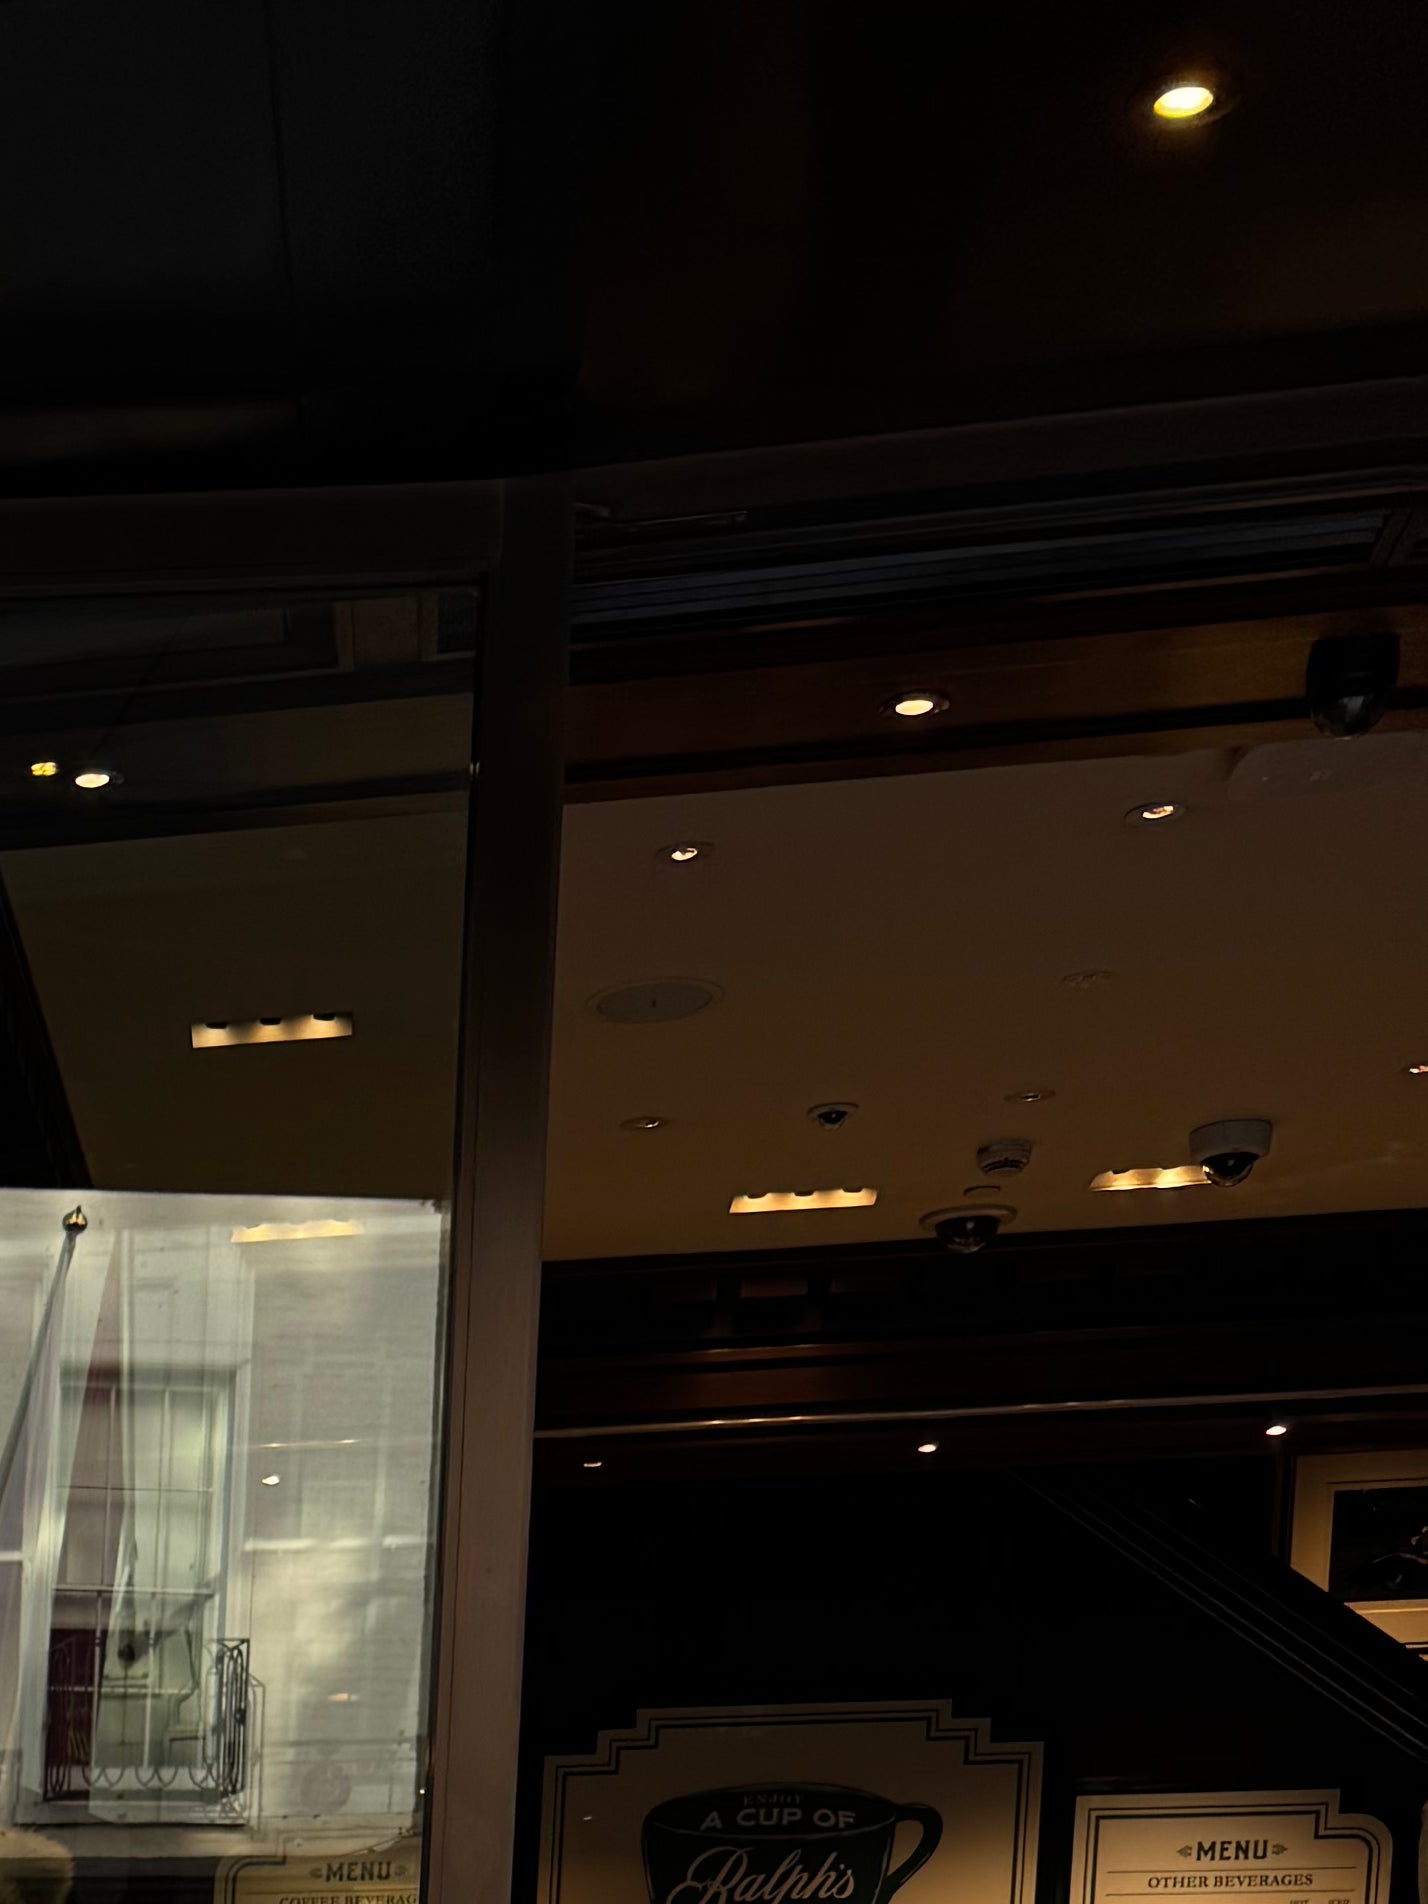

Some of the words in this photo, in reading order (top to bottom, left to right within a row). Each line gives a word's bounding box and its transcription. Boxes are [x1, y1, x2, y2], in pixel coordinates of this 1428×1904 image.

[699, 1811, 723, 1831] A
[736, 1807, 803, 1826] CUP
[813, 1808, 856, 1829] OF
[1195, 1840, 1269, 1861] MENU
[325, 1861, 393, 1883] MENU
[1147, 1875, 1209, 1889] OTHER
[1213, 1873, 1314, 1888] BEVERAGES
